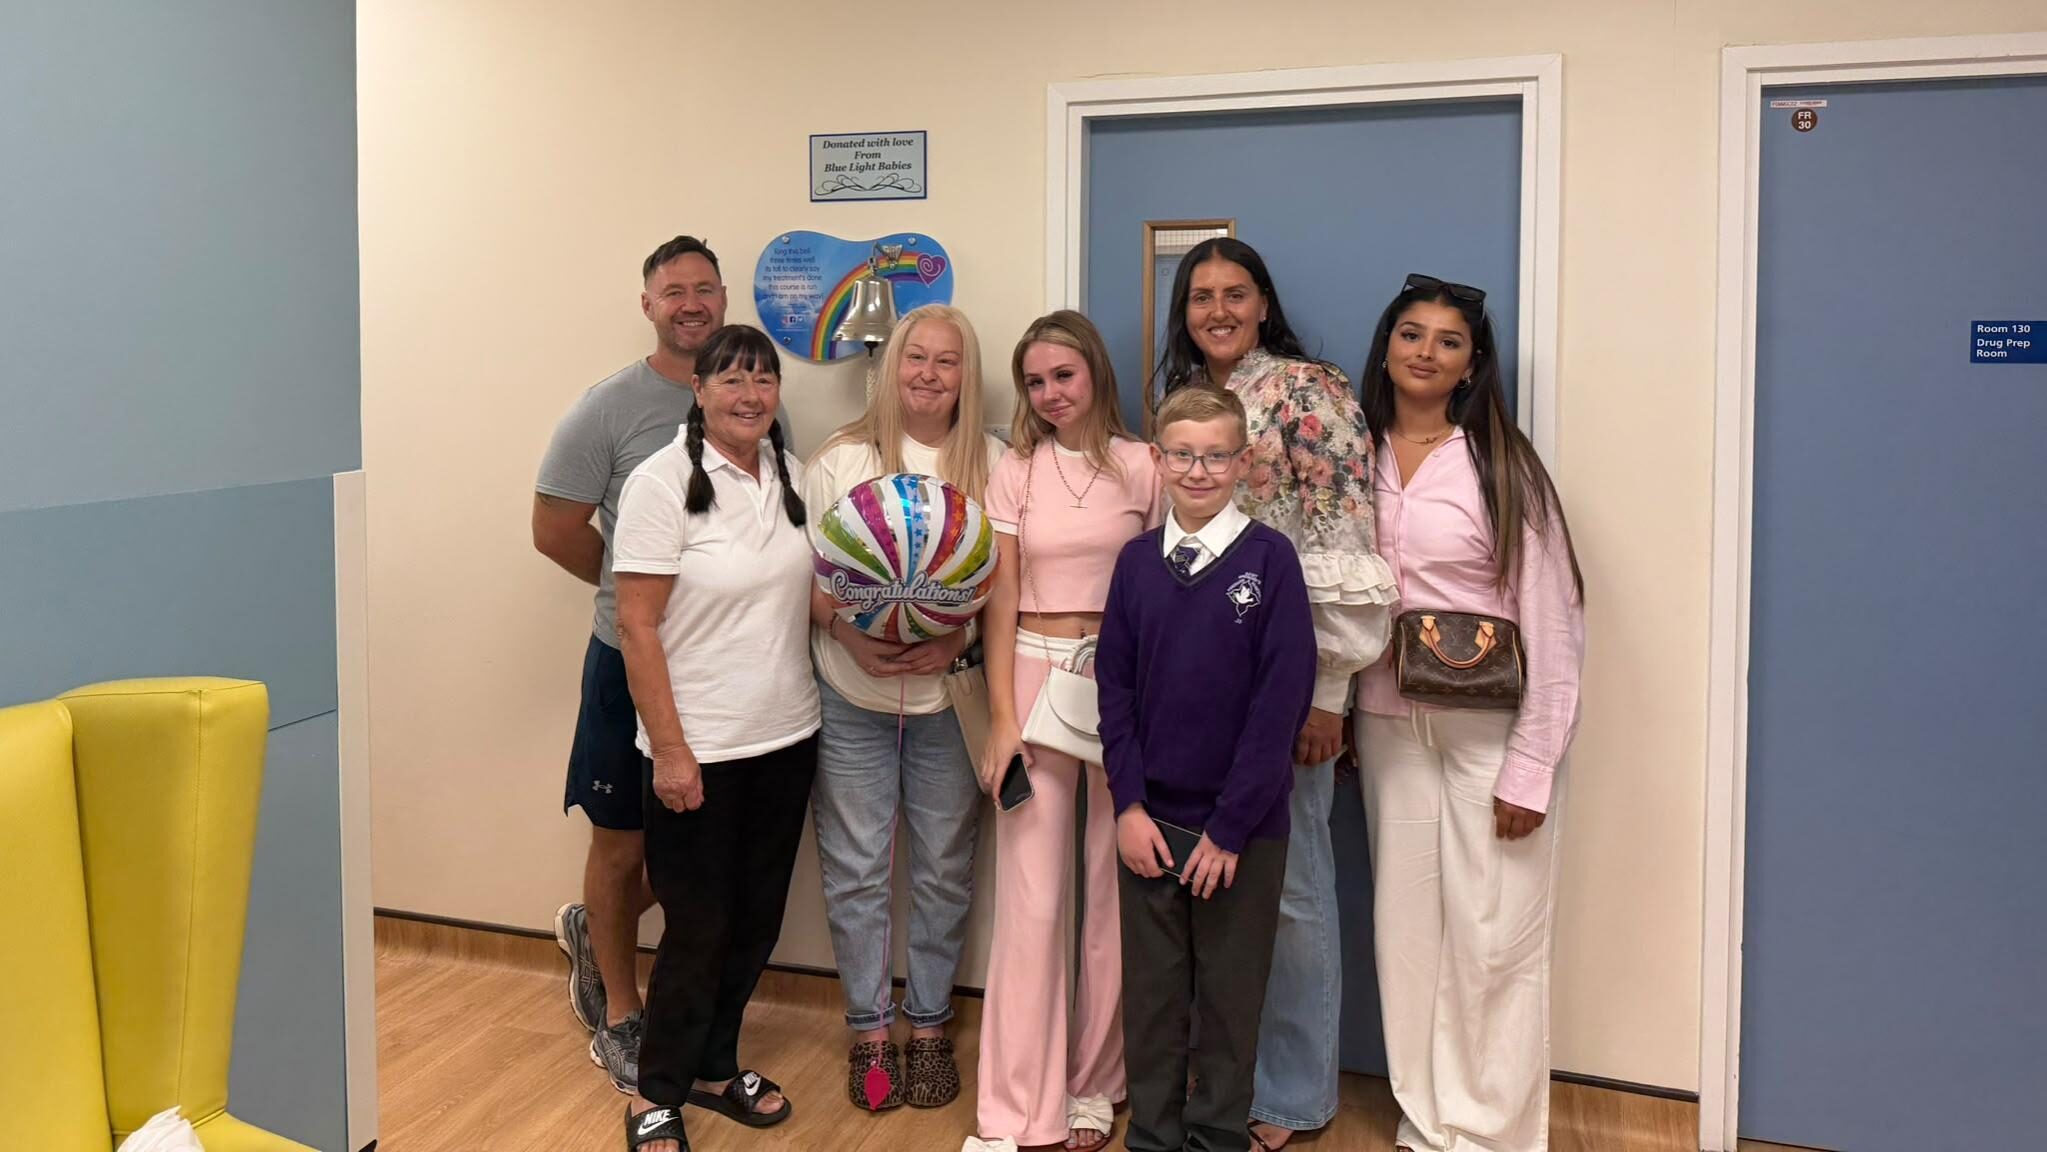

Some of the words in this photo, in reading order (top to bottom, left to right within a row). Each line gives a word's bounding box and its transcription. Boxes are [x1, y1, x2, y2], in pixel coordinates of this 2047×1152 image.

[1797, 111, 1812, 120] FR
[1798, 121, 1812, 130] 30
[823, 139, 865, 149] Donated
[867, 138, 890, 148] with
[892, 137, 914, 147] love
[854, 151, 881, 160] From
[824, 163, 847, 173] Blue
[849, 162, 876, 173] Light
[878, 161, 912, 171] Babies
[1977, 325, 2008, 333] Room
[2012, 325, 2031, 333] 130
[1977, 339, 2003, 349] Drug
[2006, 339, 2031, 349] Prep
[1976, 349, 2007, 358] Room
[831, 571, 975, 608] Congratulations!
[643, 1109, 671, 1125] NIKE
